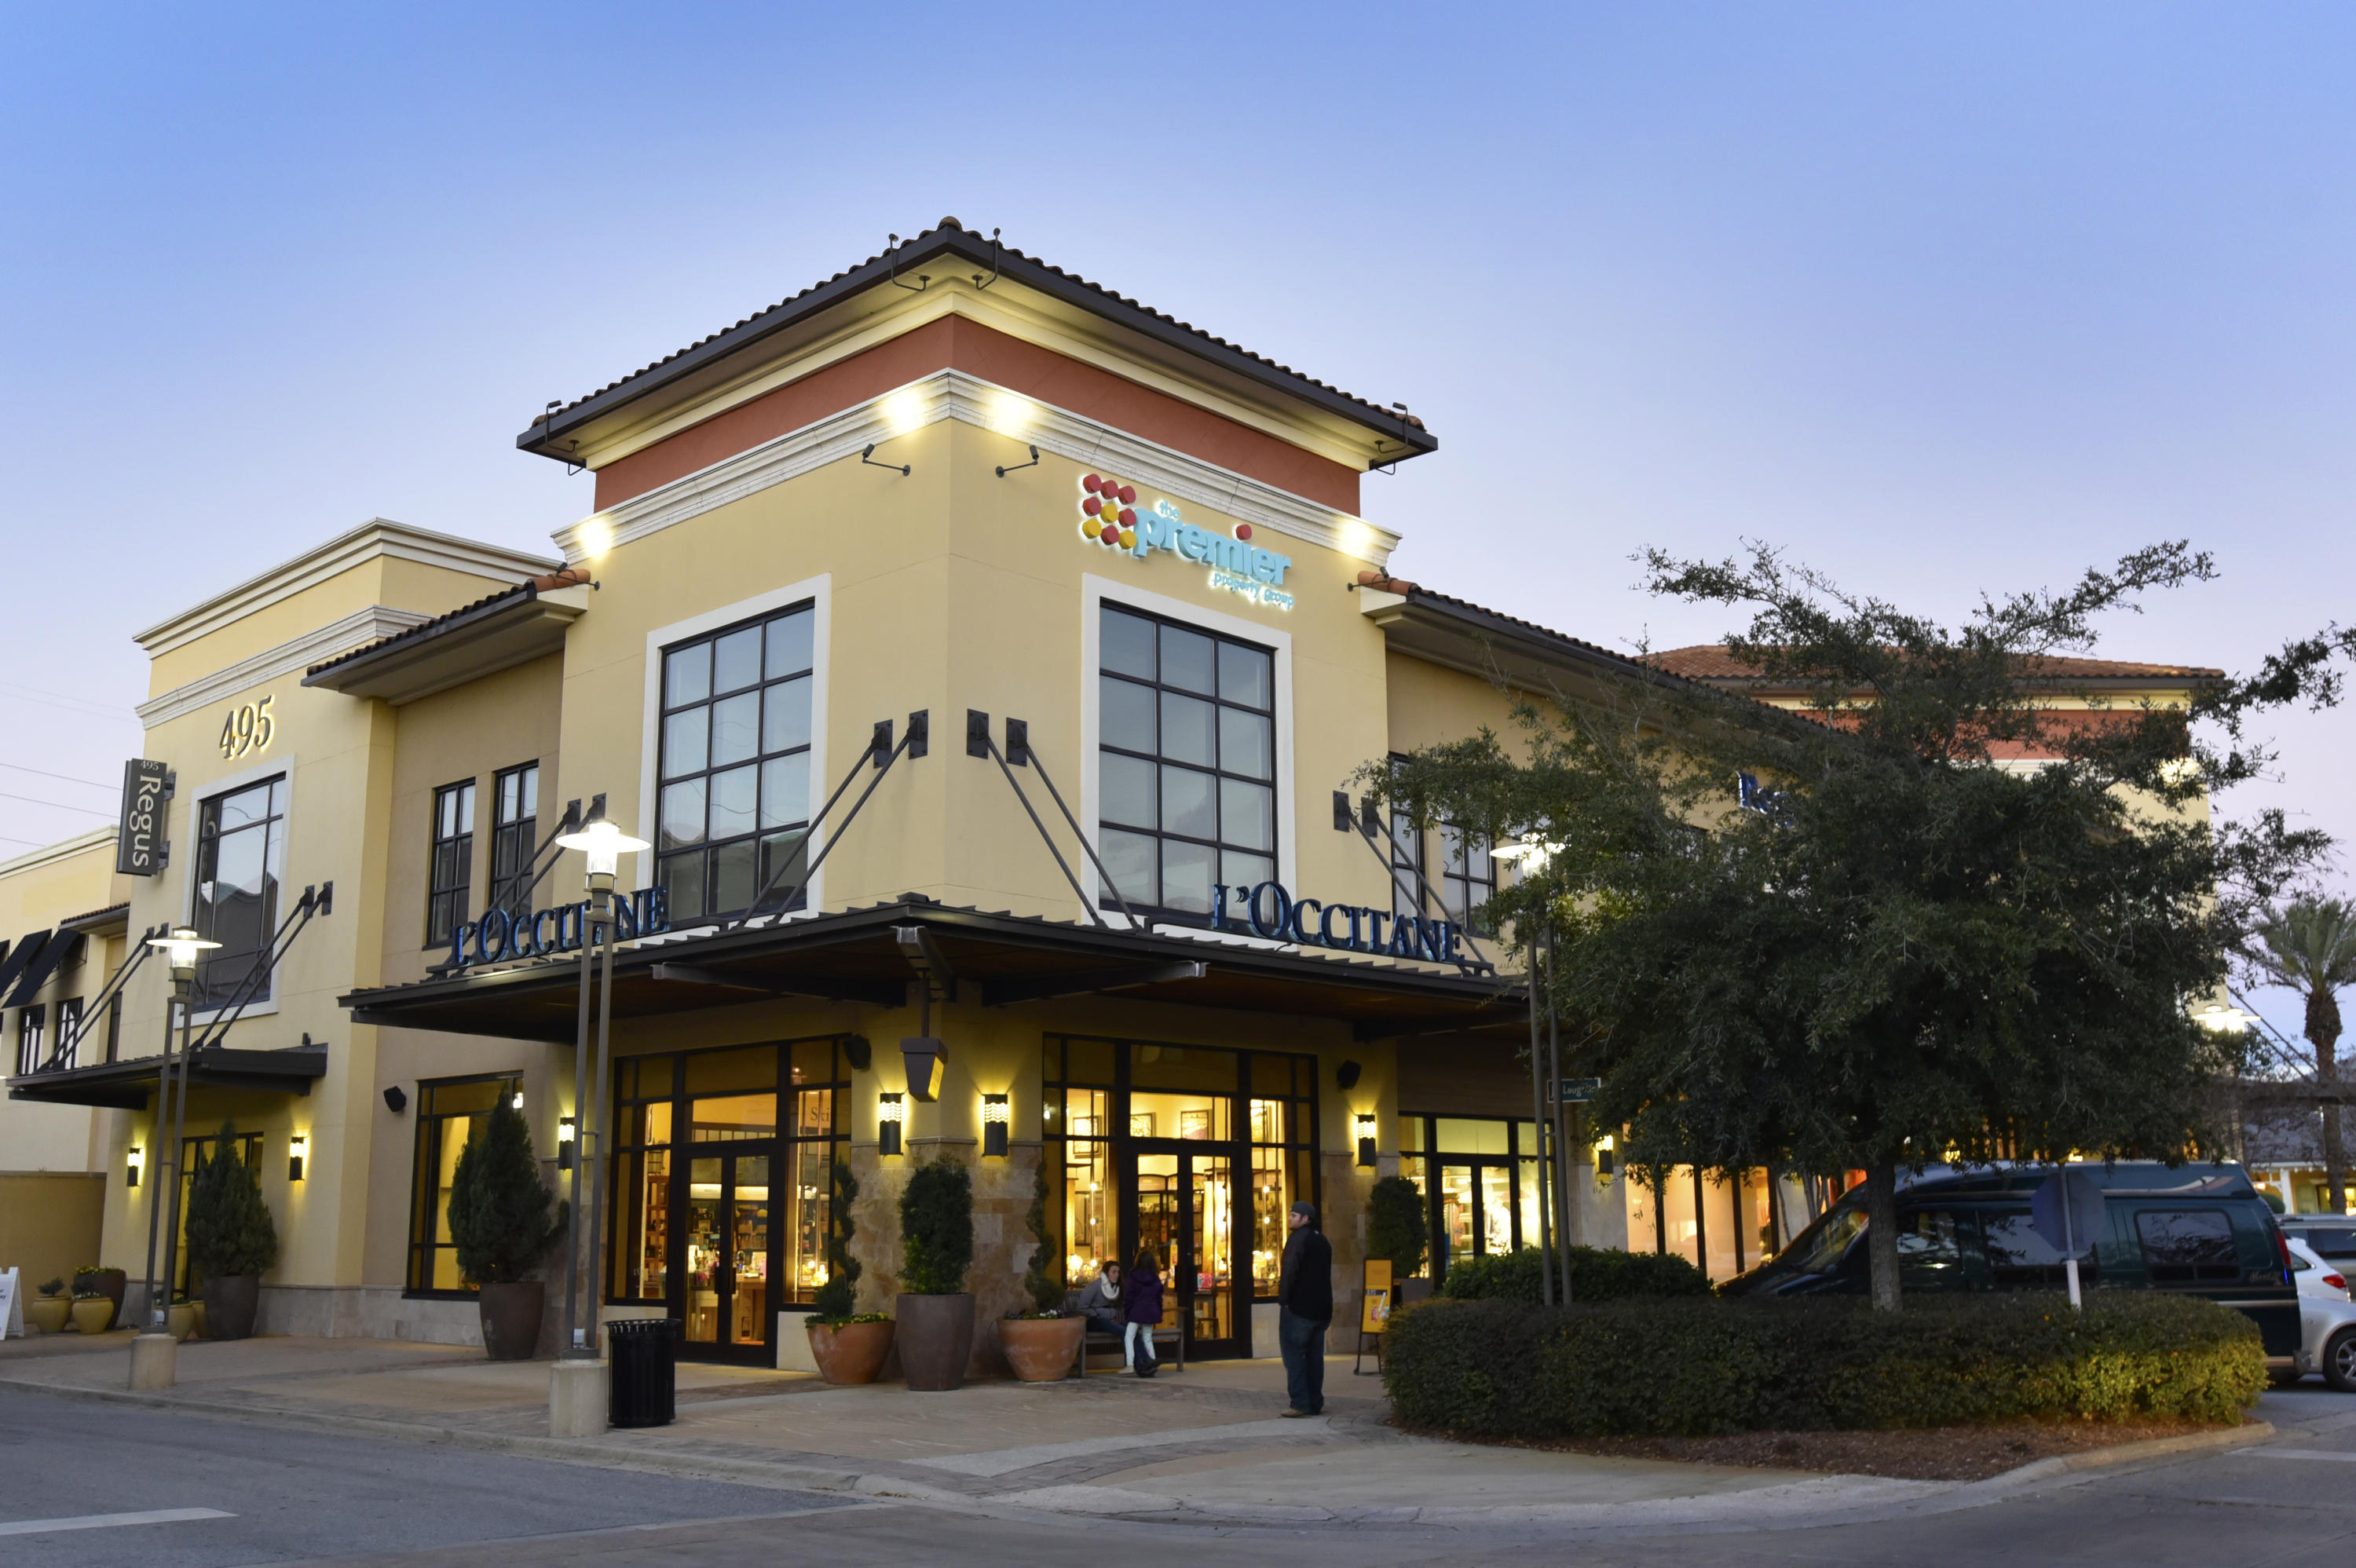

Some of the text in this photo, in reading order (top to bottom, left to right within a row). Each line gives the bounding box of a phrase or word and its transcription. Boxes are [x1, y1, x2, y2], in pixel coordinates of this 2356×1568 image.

[1159, 499, 1181, 519] the
[1132, 507, 1292, 586] premier
[1213, 572, 1295, 610] property group
[219, 694, 273, 759] 495
[140, 760, 159, 771] 495
[129, 775, 162, 868] Regus
